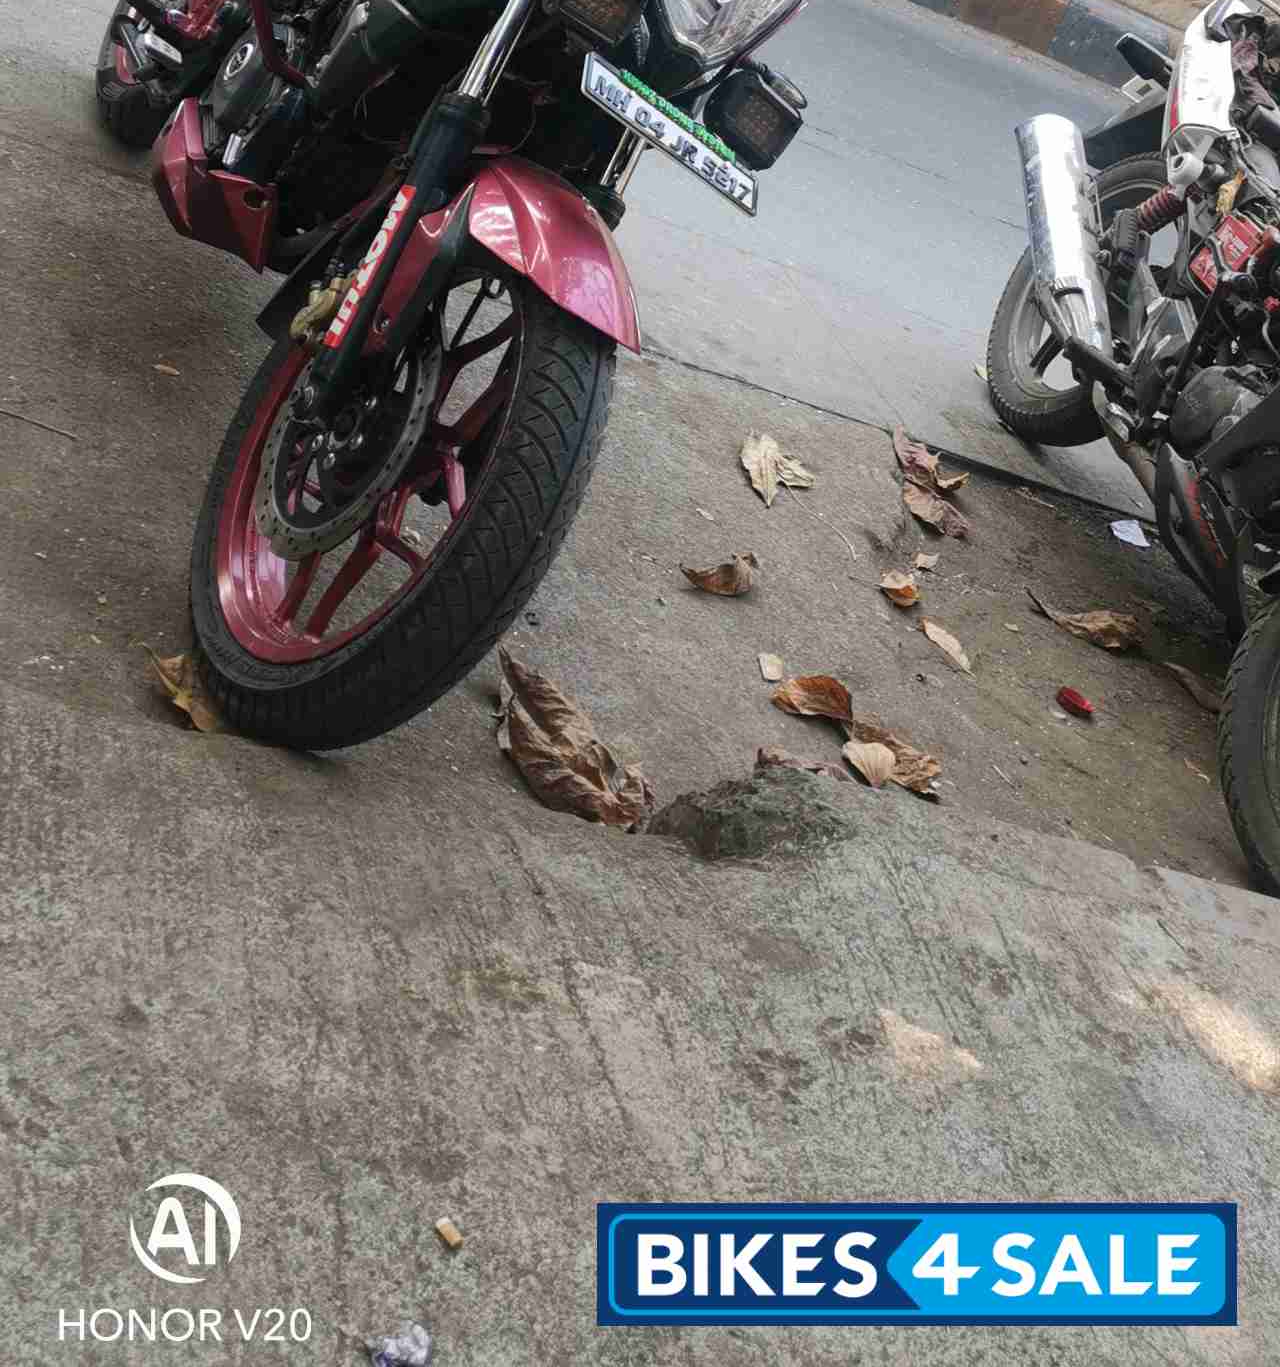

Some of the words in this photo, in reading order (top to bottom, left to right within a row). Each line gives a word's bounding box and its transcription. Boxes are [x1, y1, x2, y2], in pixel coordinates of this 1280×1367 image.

[594, 75, 632, 113] MH
[634, 106, 666, 138] 04
[670, 135, 699, 165] JR
[328, 191, 408, 335] MOTUL
